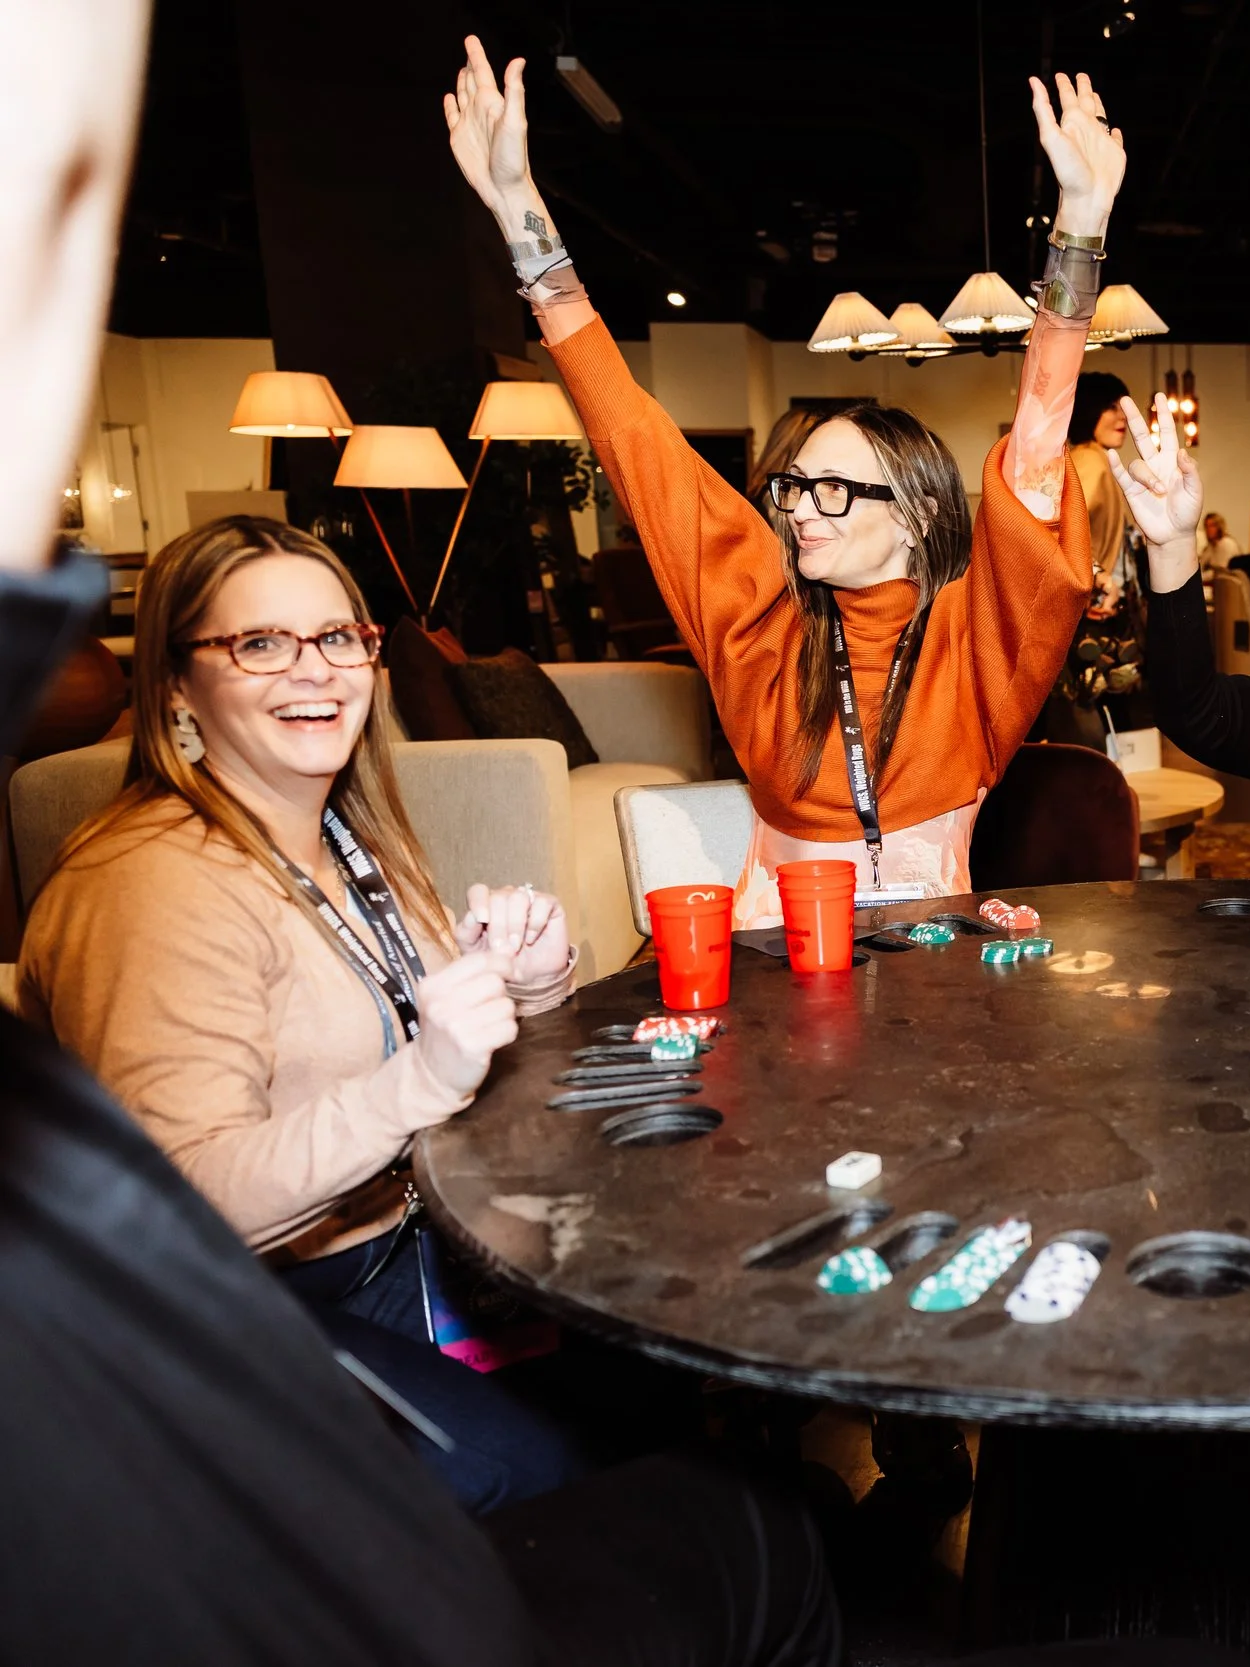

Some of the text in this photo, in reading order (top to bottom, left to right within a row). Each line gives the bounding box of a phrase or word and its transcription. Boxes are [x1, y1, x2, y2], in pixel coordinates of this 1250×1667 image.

[852, 745, 863, 760] Rugs
[852, 760, 867, 791] Weighted
[326, 817, 358, 856] Weighted
[337, 925, 374, 966] Weighted
[367, 961, 388, 985] Rugs
